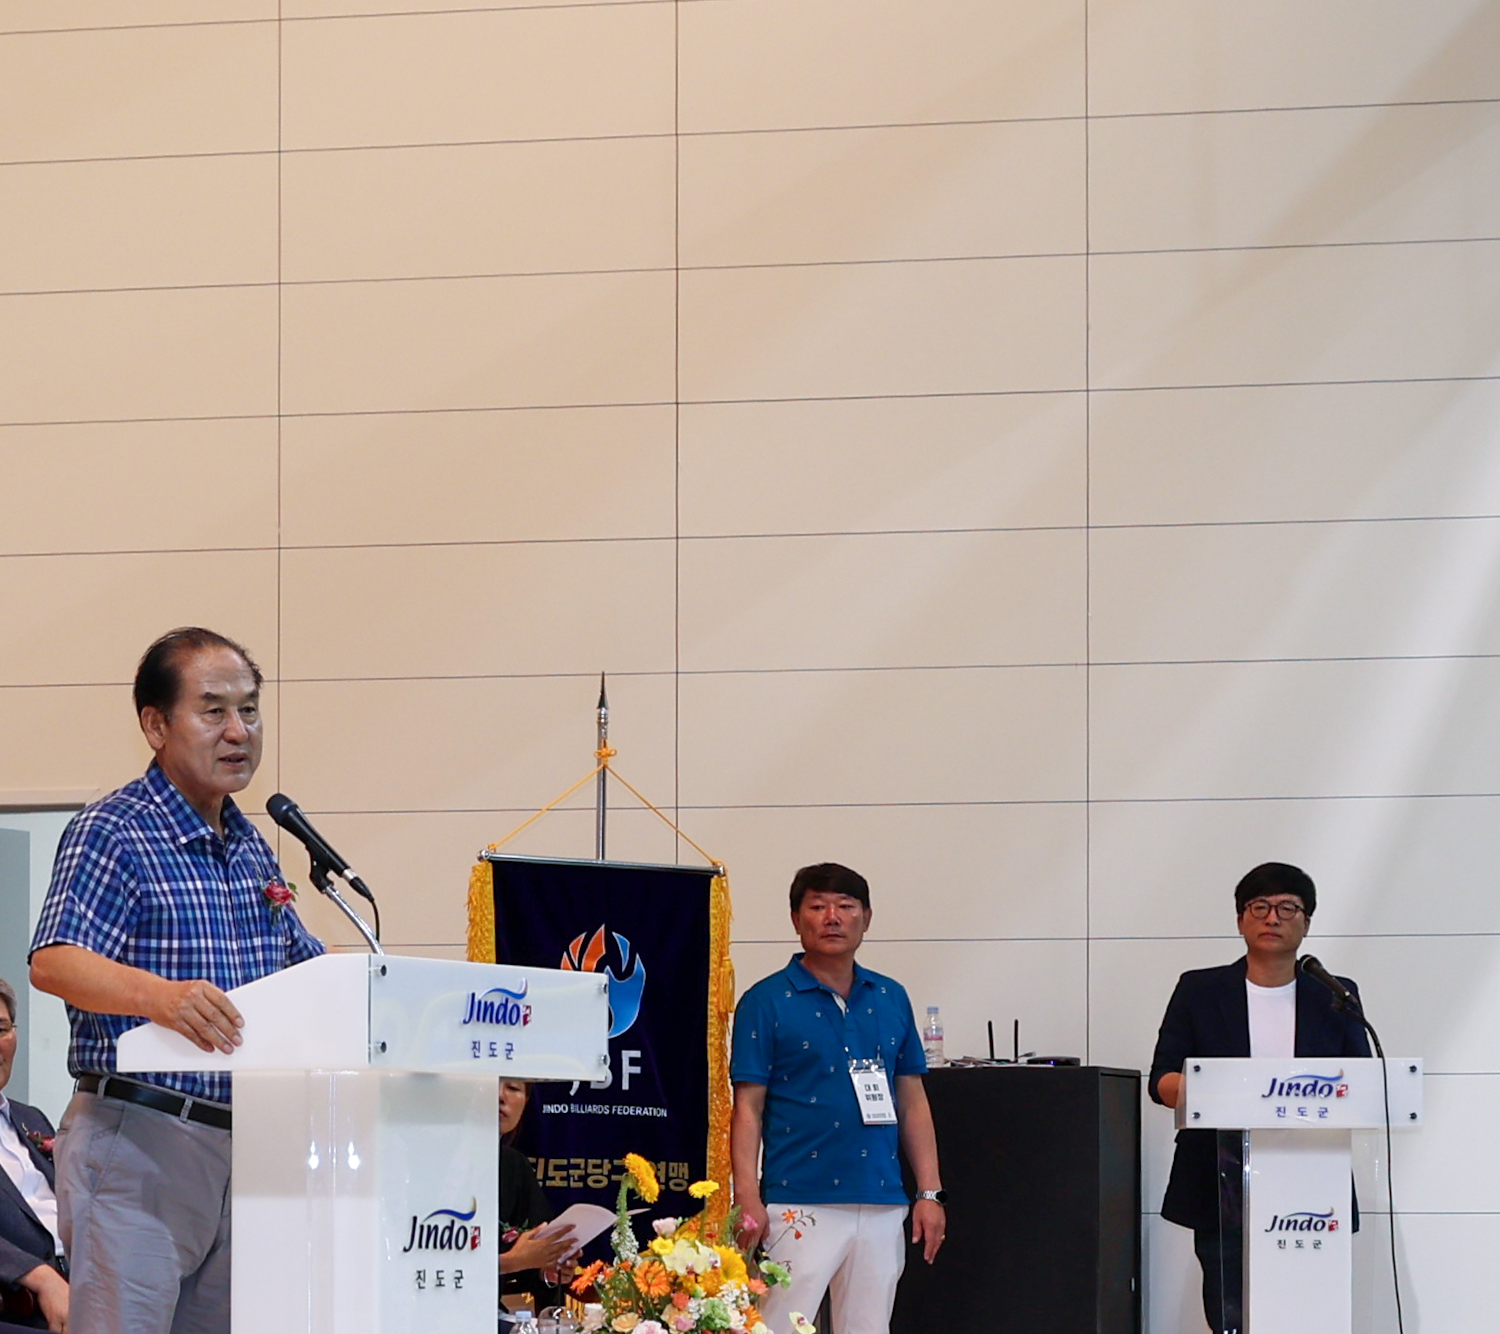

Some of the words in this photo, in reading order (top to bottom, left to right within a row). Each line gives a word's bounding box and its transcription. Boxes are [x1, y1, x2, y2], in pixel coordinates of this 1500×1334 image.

[462, 992, 521, 1026] Jindo
[1261, 1077, 1333, 1098] Jindo
[542, 1103, 568, 1114] JINDO
[570, 1103, 609, 1115] BILLIARDS
[612, 1105, 667, 1117] FEDERATION
[403, 1215, 468, 1253] Jindo
[1264, 1215, 1326, 1232] Jindo
